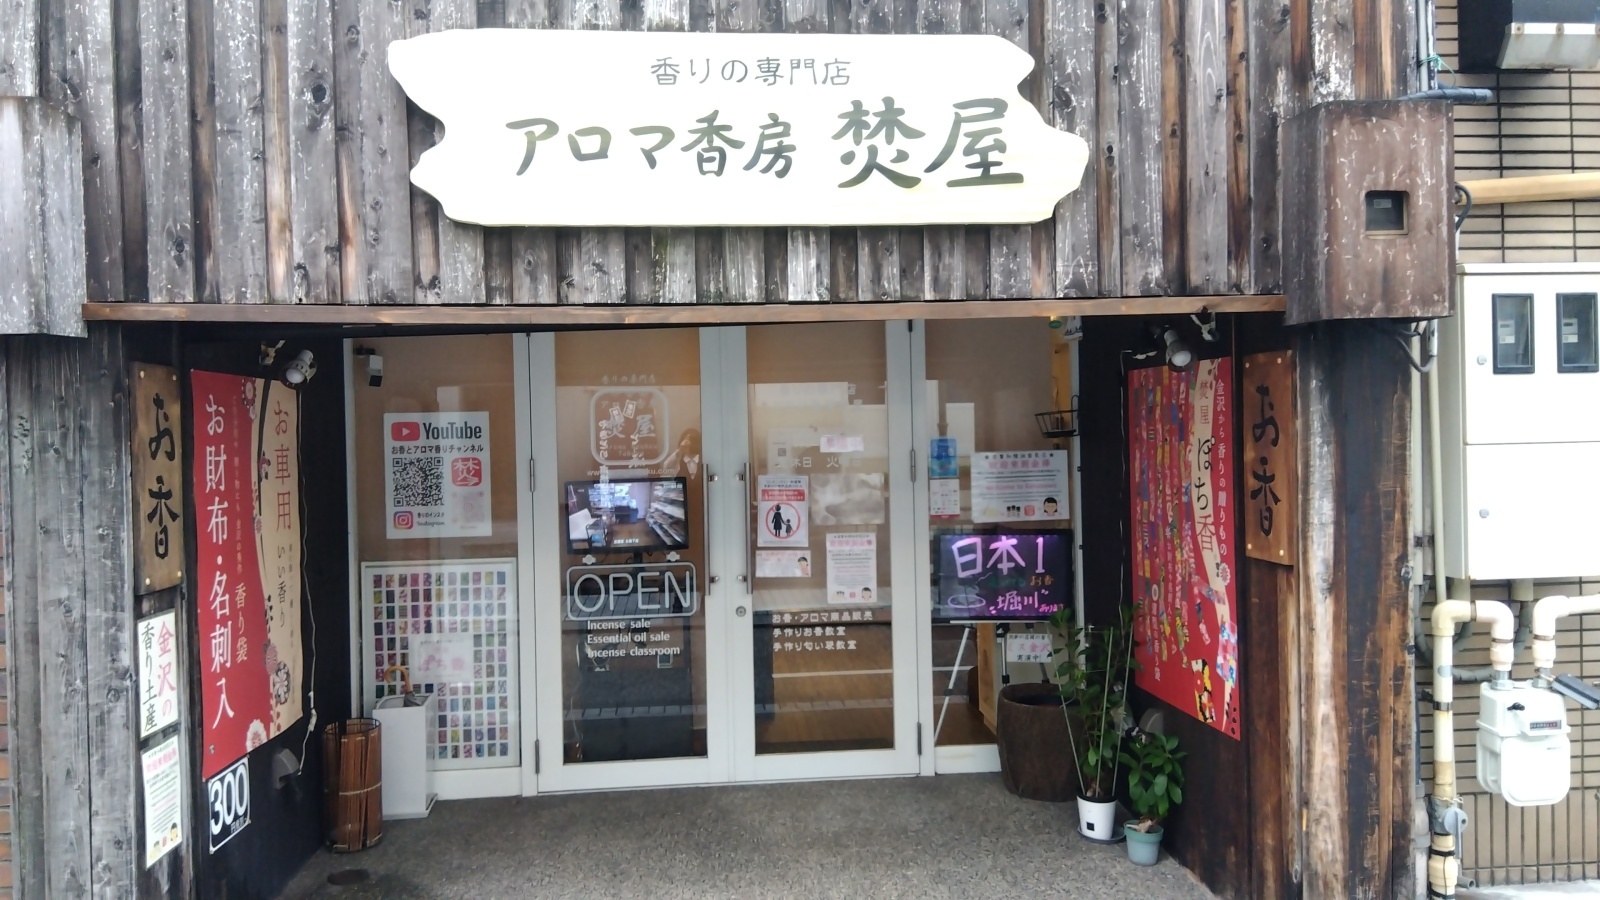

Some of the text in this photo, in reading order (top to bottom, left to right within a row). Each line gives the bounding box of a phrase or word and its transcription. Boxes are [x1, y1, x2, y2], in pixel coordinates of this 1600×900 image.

[651, 57, 851, 86] 香りの専門店
[506, 96, 1024, 189] アロマ香房 焚屋
[423, 421, 482, 440] YouTube
[1216, 379, 1226, 437] 金沢から
[147, 392, 180, 560] お香
[274, 400, 292, 532] お車用
[391, 444, 484, 455] お香とアロマ香りチャンネル
[1251, 385, 1281, 537] お香
[205, 394, 234, 730] お財布・名刺入
[277, 545, 287, 629] いい香り
[574, 571, 690, 612] OPEN
[235, 582, 248, 663] 香り袋
[587, 618, 651, 630] Incense sale
[587, 630, 671, 644] Essential oil sale
[587, 645, 680, 658] Incense classroom
[772, 626, 846, 638] 手作りお香教室
[141, 622, 157, 732] 香り土産
[157, 621, 176, 717] 金沢の
[210, 765, 248, 836] 300
